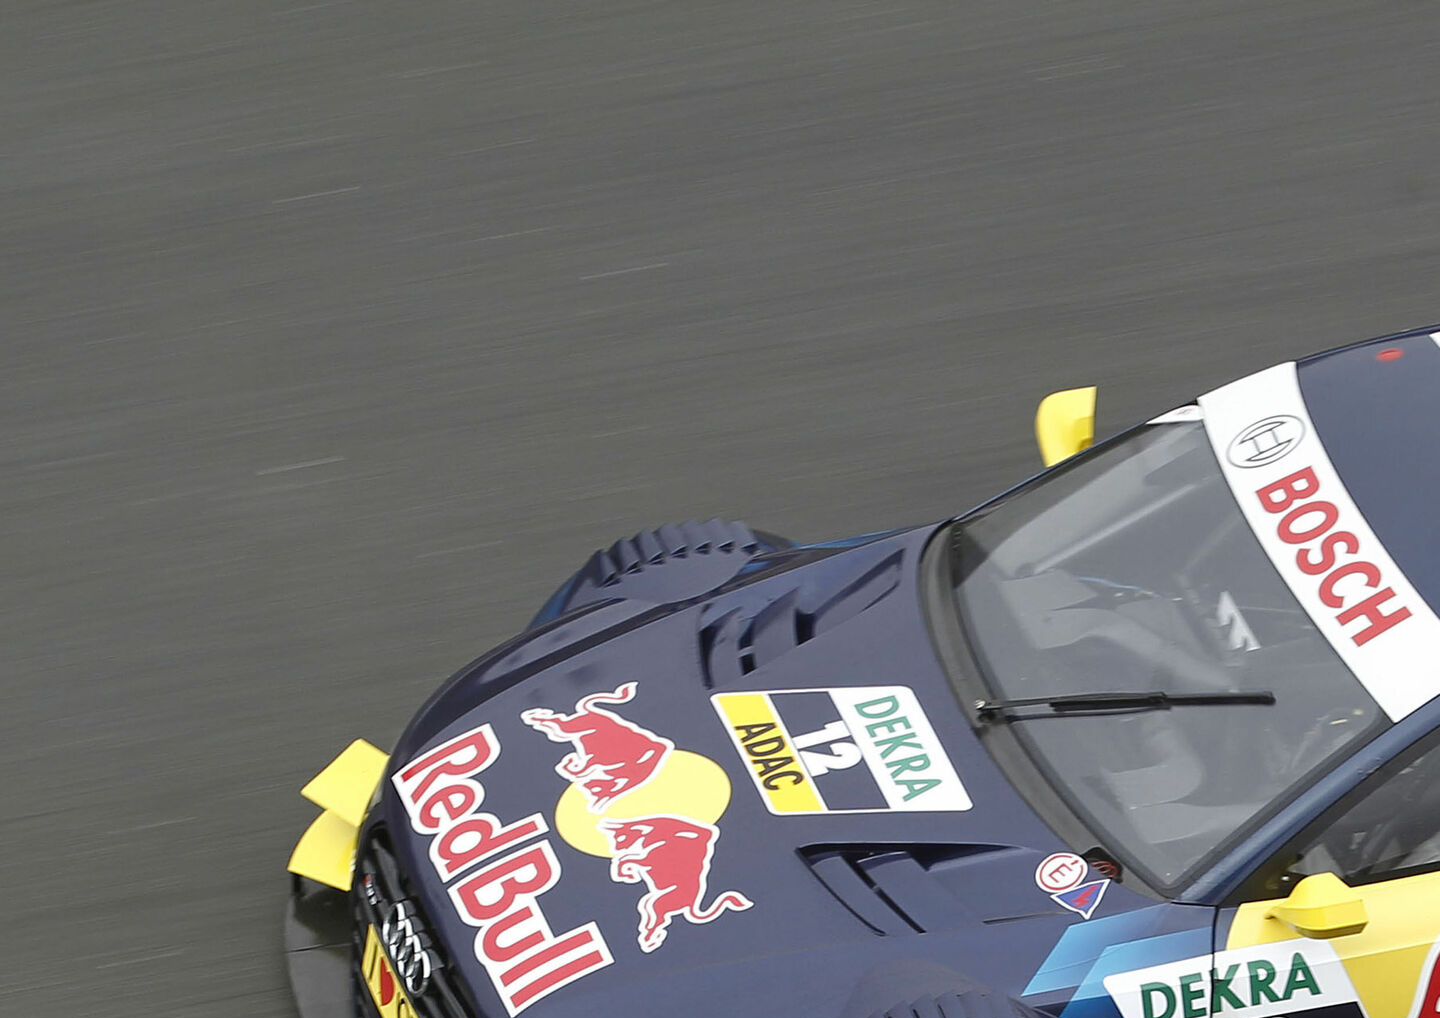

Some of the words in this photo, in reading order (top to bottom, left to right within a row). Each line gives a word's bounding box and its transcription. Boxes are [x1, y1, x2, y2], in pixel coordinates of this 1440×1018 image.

[1254, 466, 1412, 647] BOSCH
[735, 722, 804, 792] ADAC
[792, 721, 864, 777] 12
[854, 695, 942, 802] DEKRA
